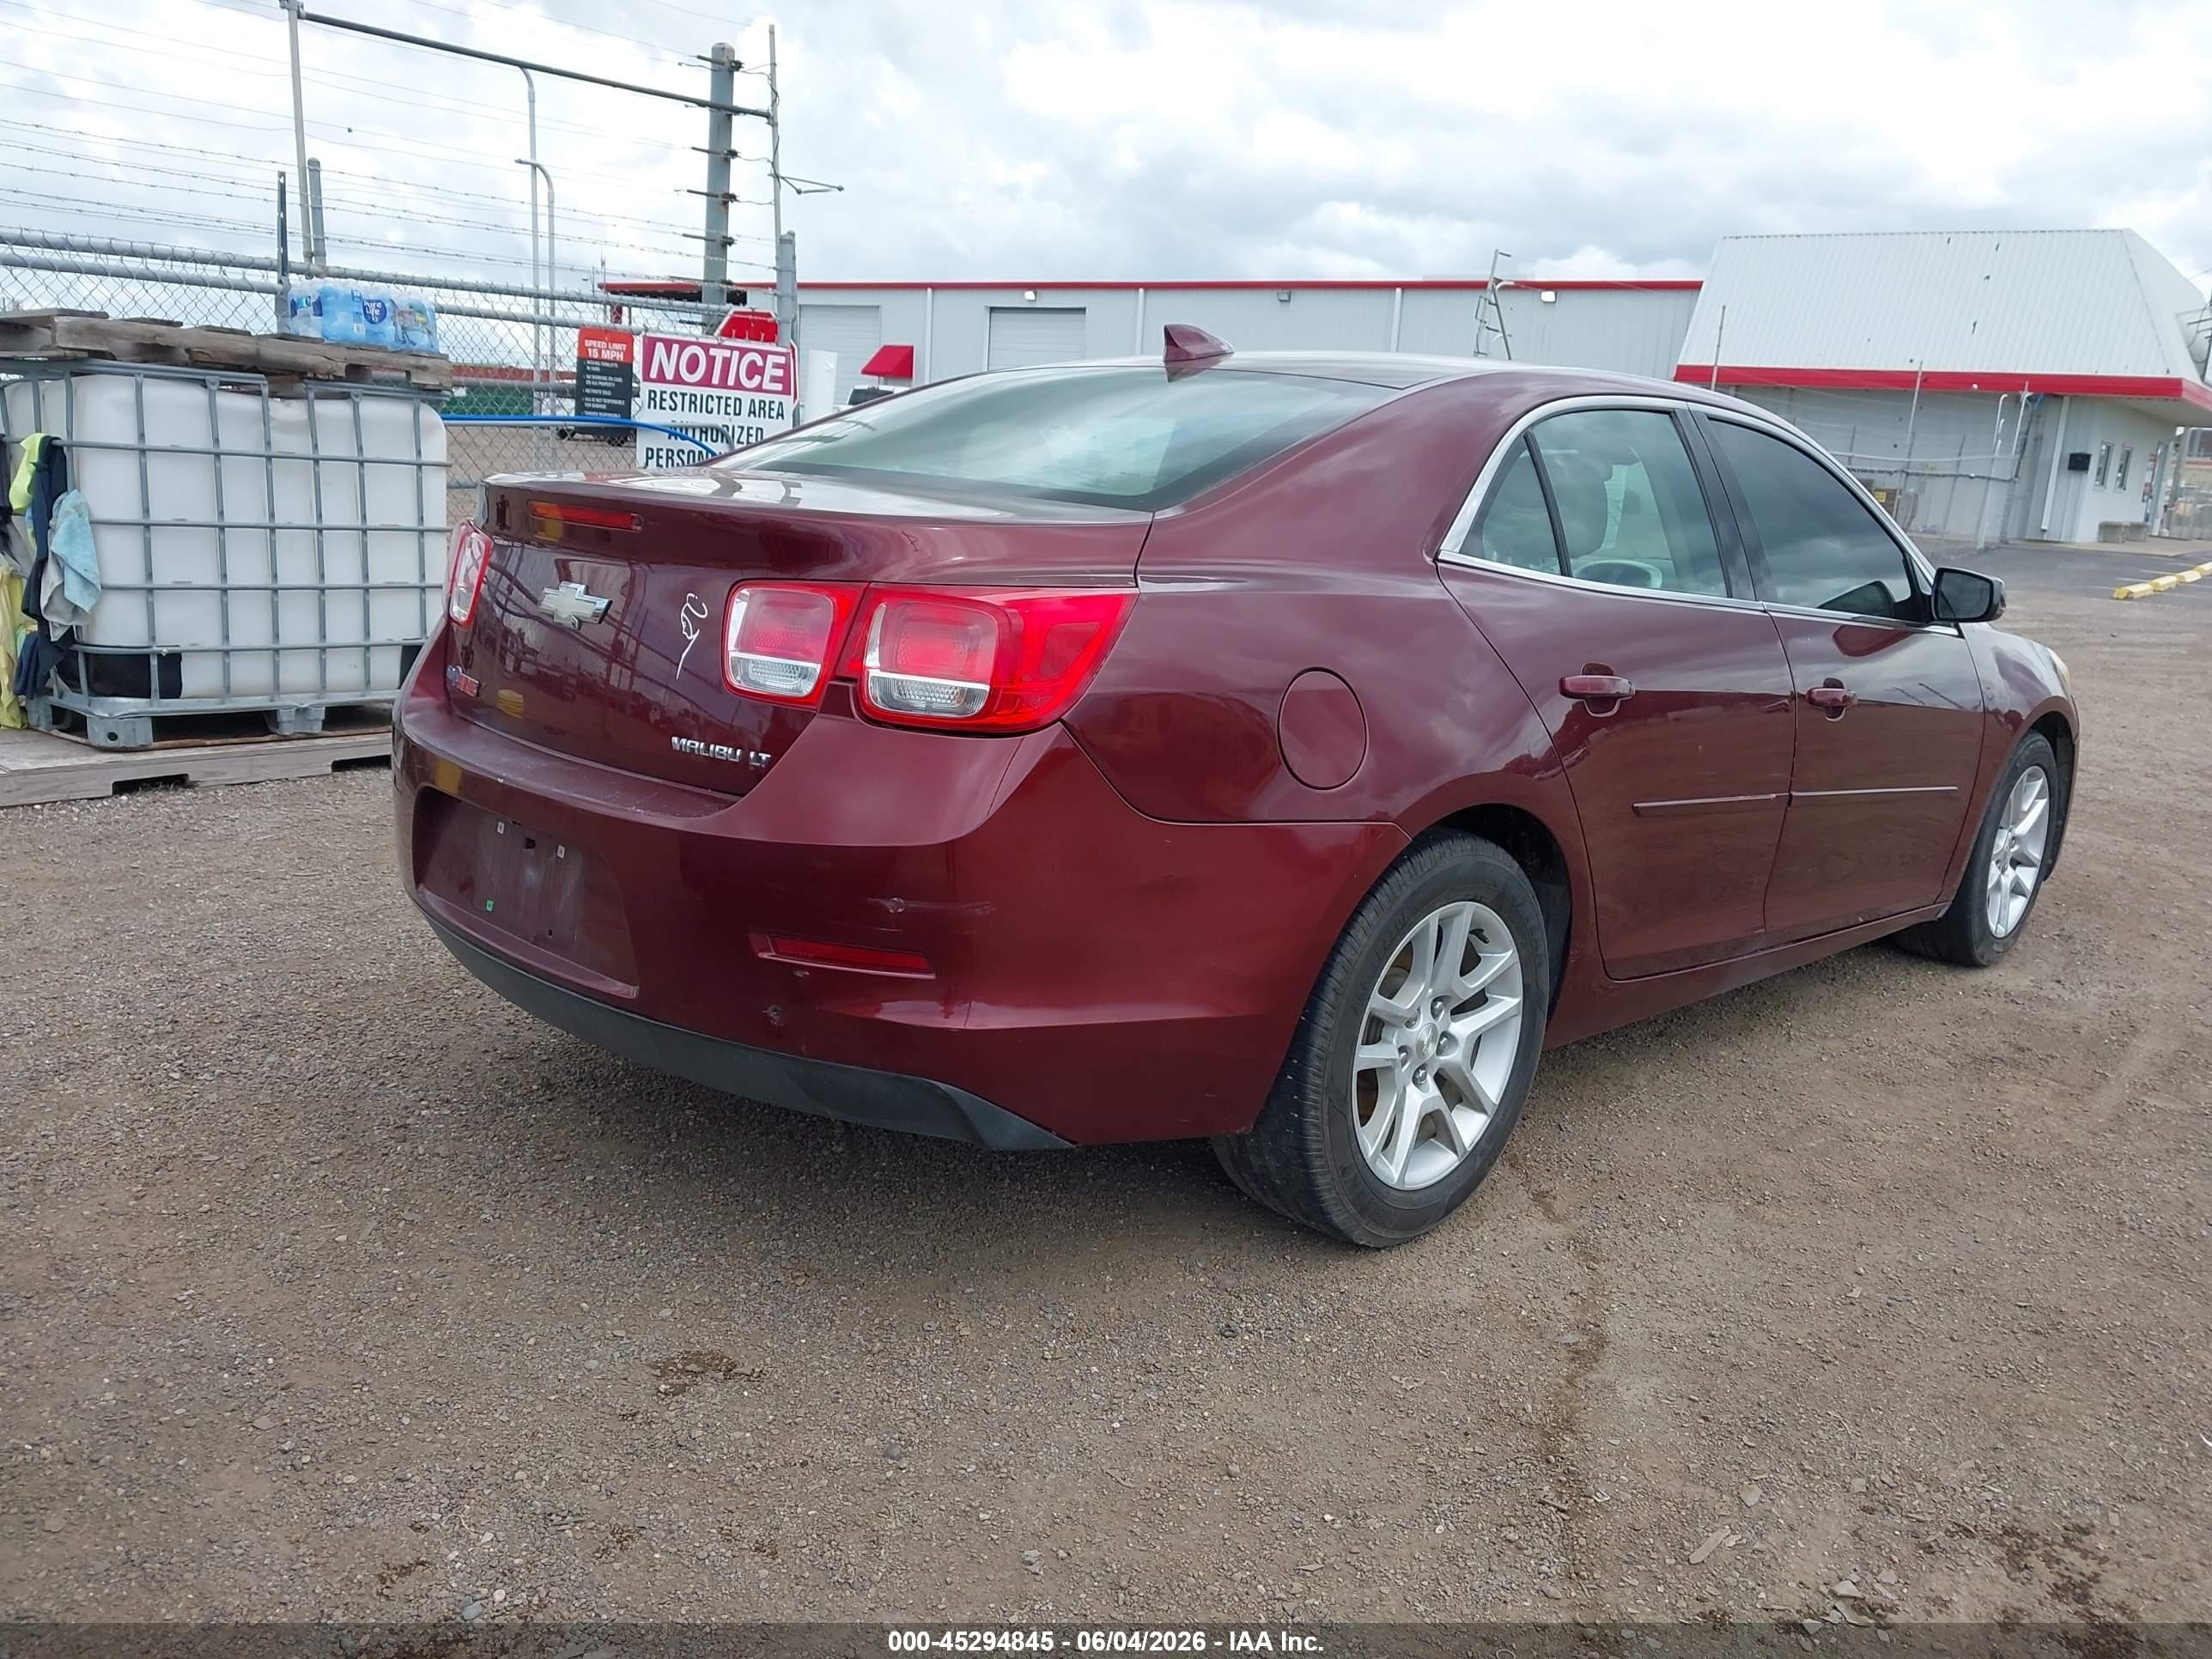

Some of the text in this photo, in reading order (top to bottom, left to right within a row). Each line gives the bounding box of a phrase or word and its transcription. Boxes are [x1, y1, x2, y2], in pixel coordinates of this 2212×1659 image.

[365, 307, 380, 316] Life
[584, 339, 627, 351] SPEED LIMIT
[588, 348, 624, 361] 15 MPH
[649, 342, 786, 391] NOTICE
[647, 389, 785, 420] RESTRICTED AREA
[672, 736, 771, 768] MALIBU LT
